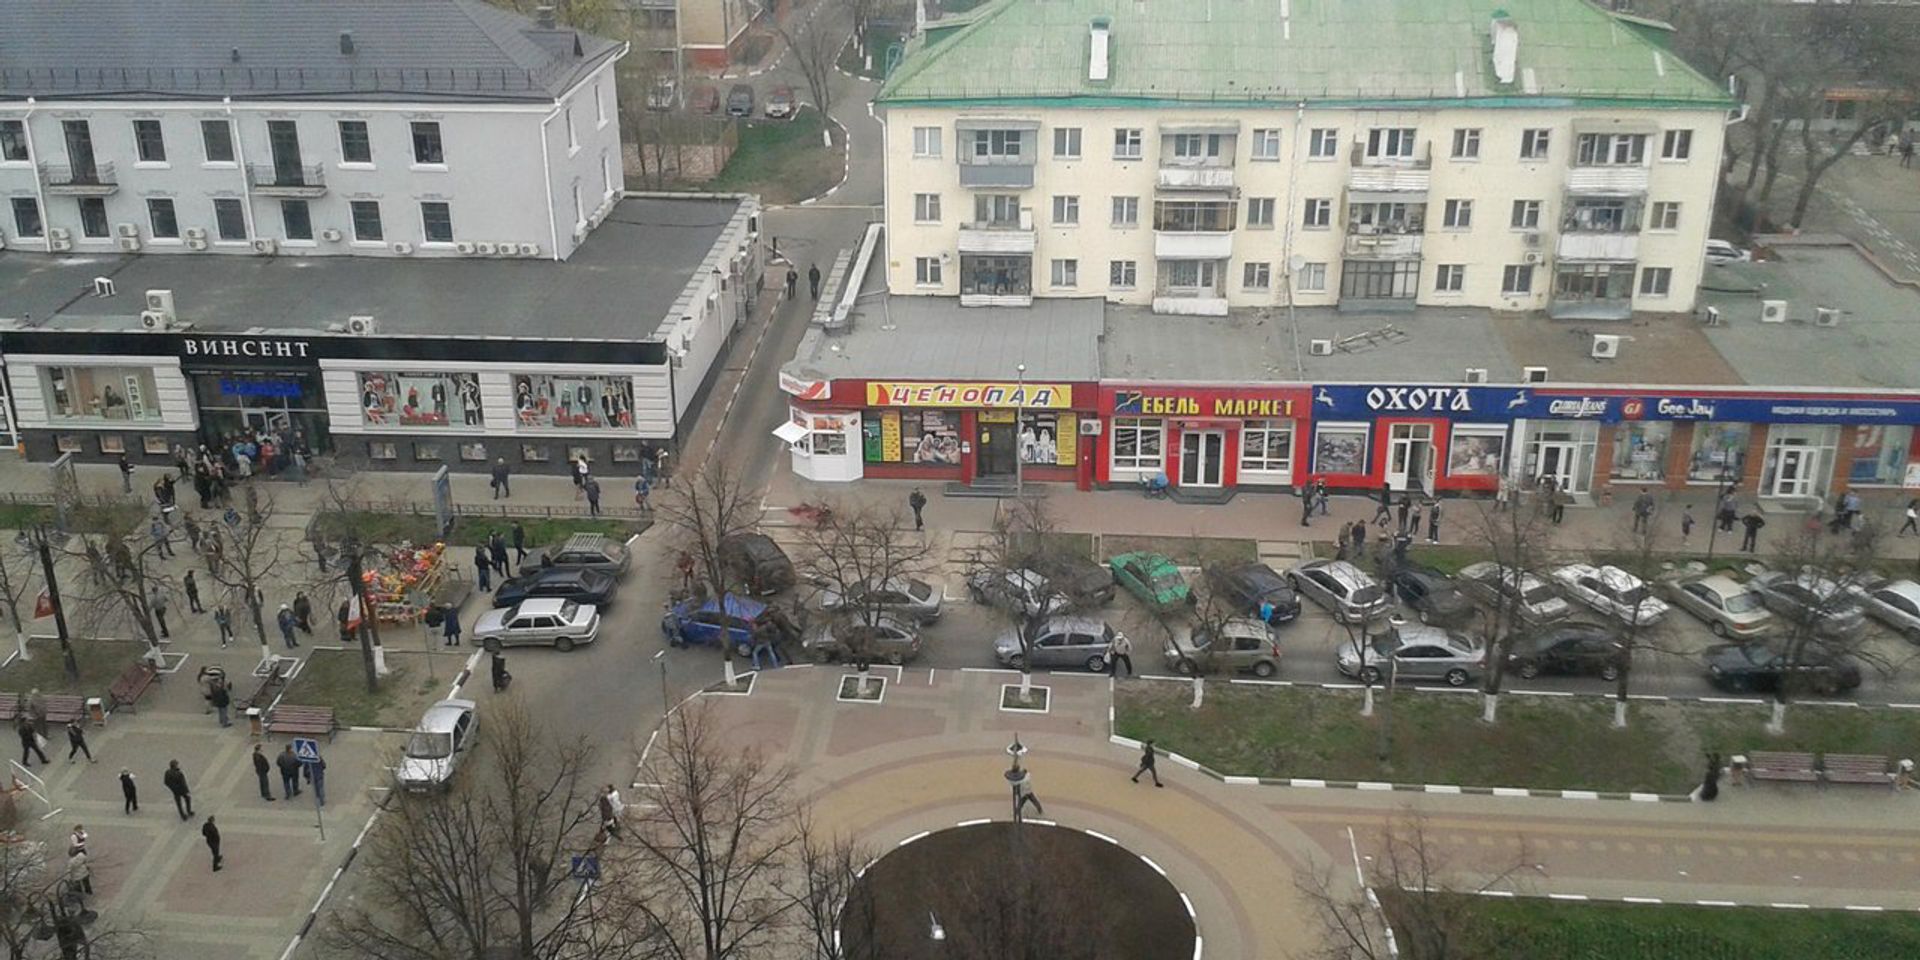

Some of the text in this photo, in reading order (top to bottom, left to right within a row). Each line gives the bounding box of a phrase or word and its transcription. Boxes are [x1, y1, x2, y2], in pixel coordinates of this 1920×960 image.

[184, 339, 309, 357] ВИНСЕНТ
[892, 385, 1053, 407] ЦЕНОПАД
[1366, 387, 1473, 411] ОХОТА
[1214, 398, 1294, 415] МАРКЕТ
[1624, 402, 1643, 415] GJ
[1658, 398, 1715, 419] Gee Jay
